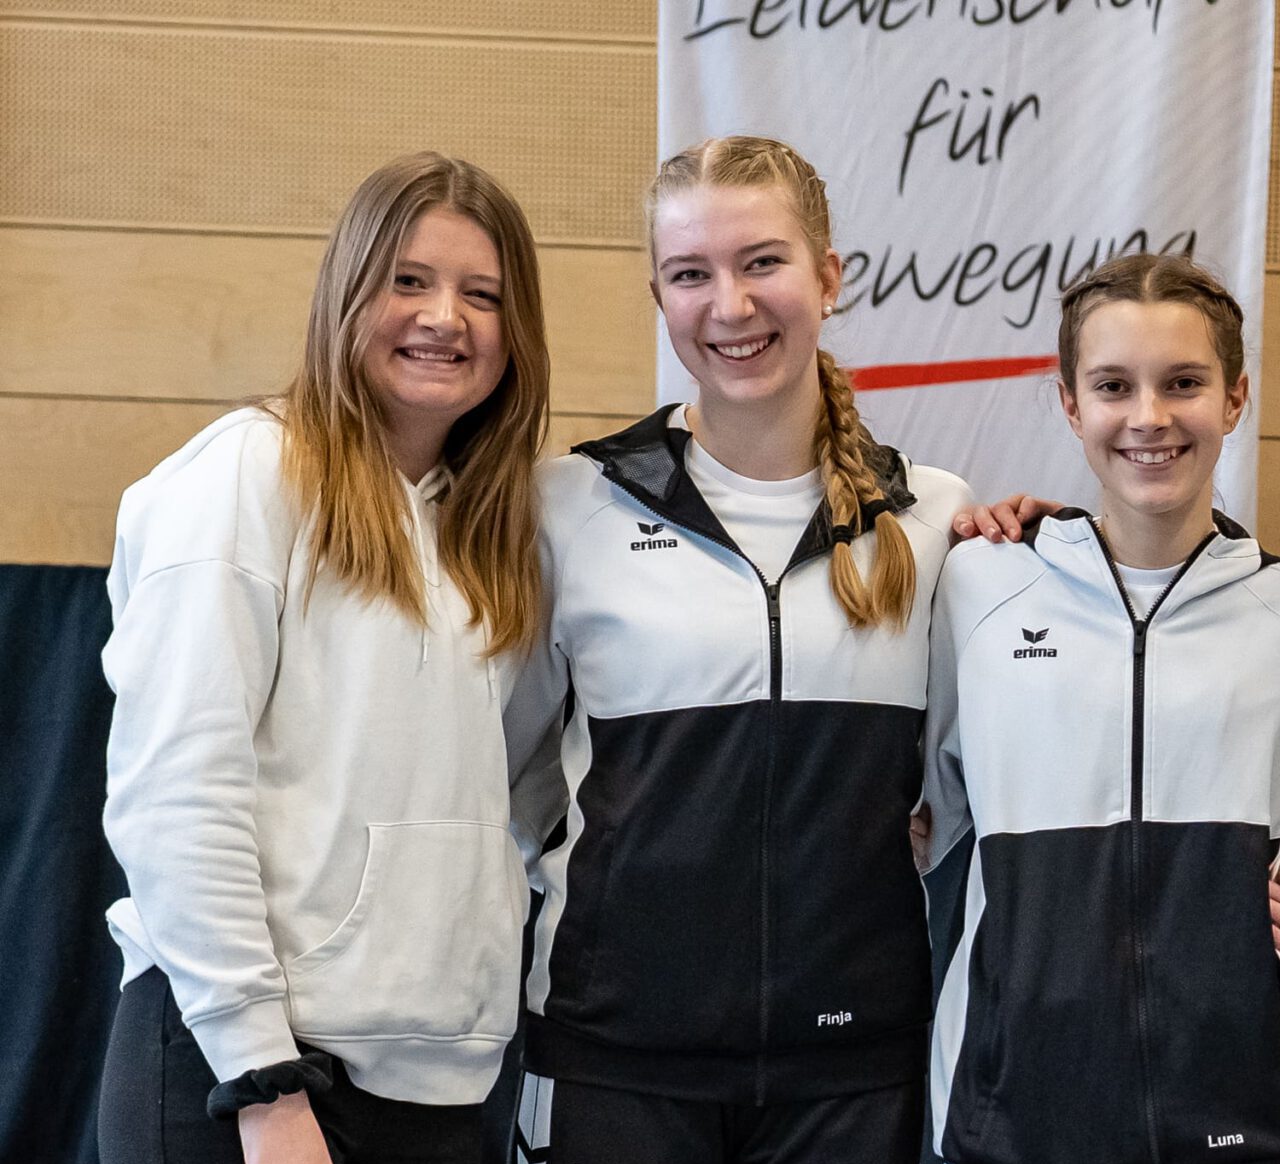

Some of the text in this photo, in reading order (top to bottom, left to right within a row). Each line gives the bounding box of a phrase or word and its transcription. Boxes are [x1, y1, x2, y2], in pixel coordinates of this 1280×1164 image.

[898, 78, 1039, 196] für
[630, 539, 678, 551] erima
[1013, 646, 1058, 659] erima
[817, 1010, 853, 1026] Finja
[1207, 1133, 1245, 1148] Luna
